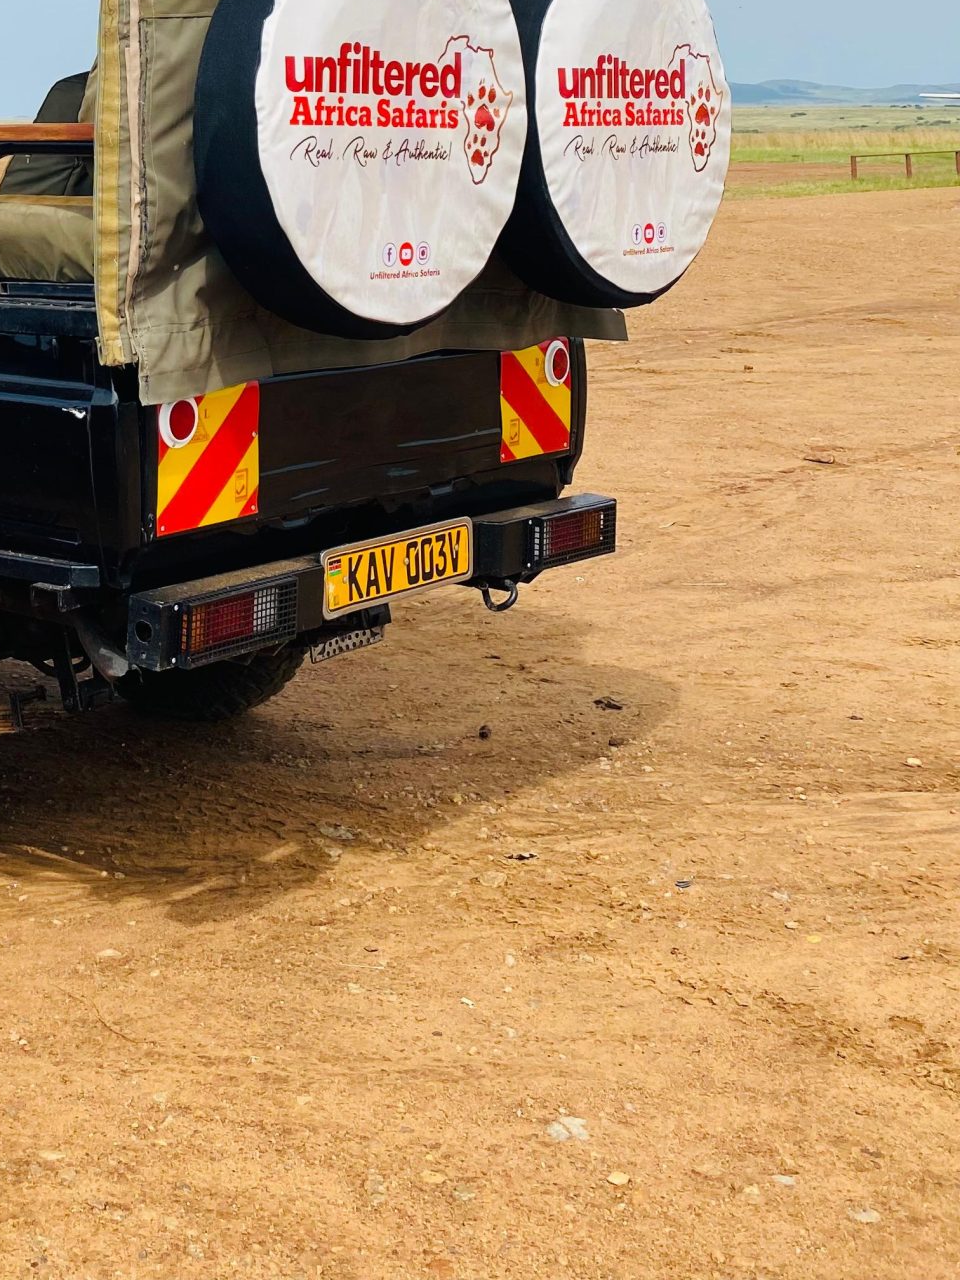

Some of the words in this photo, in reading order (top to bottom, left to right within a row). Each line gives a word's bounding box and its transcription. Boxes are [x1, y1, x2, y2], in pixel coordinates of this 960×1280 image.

[285, 42, 461, 98] unfiltered
[557, 54, 686, 99] unfiltered
[290, 96, 372, 128] Africa
[377, 98, 459, 129] Safaris
[563, 101, 622, 127] Africa
[625, 101, 684, 127] Safaris
[342, 135, 378, 167] Raw
[382, 138, 394, 165] &
[601, 134, 627, 161] Raw
[370, 270, 400, 280] Unfiltered
[401, 270, 418, 278] Africa
[420, 268, 441, 277] Safaris
[348, 547, 395, 602] KAV
[406, 530, 461, 586] 003V
